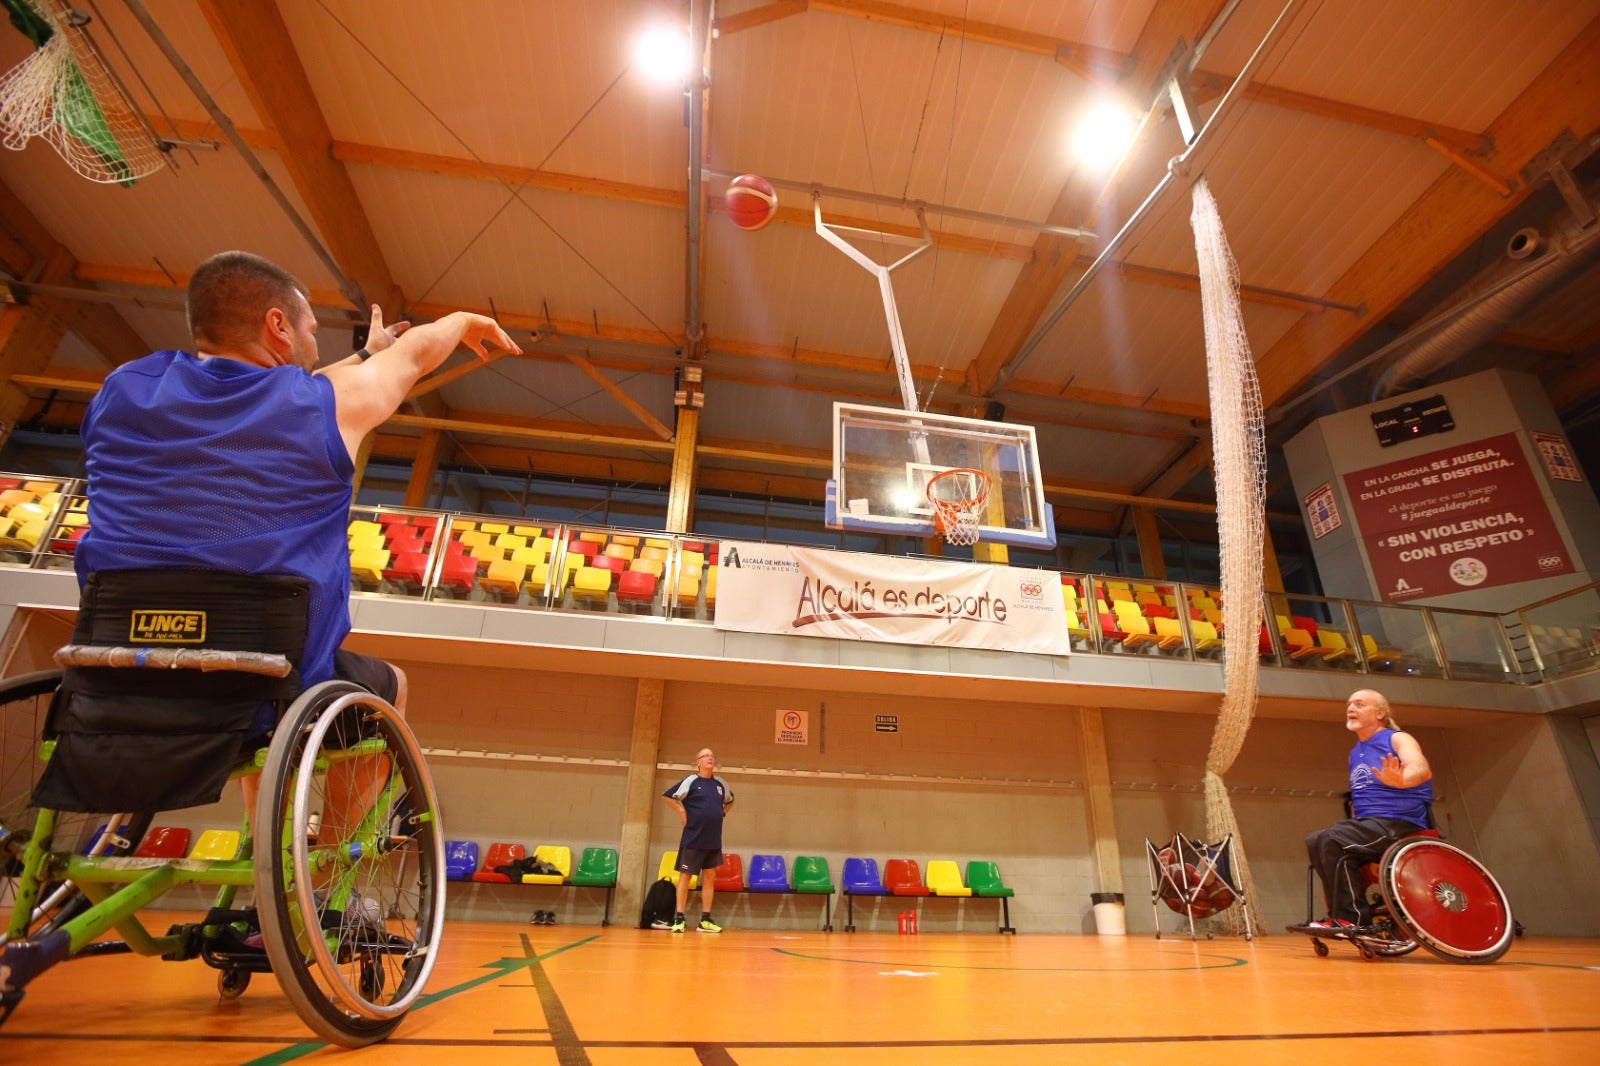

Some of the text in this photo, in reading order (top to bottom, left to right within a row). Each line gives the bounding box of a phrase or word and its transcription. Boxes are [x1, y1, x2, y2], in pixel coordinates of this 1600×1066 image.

[1375, 419, 1399, 429] LOCAL
[1360, 459, 1515, 501] EN LA GRADA SE DISFRUTA.
[1364, 448, 1500, 488] EN LA CANCHA SE JUEGA,
[1388, 483, 1498, 513] el deporte es un juego
[1387, 532, 1417, 548] SIN
[1419, 512, 1525, 540] VIOLENCIA,
[1399, 546, 1437, 563] CON
[1440, 528, 1523, 555] RESPETO
[796, 576, 1008, 624] Alcalá es deporte
[137, 614, 199, 632] LINCE
